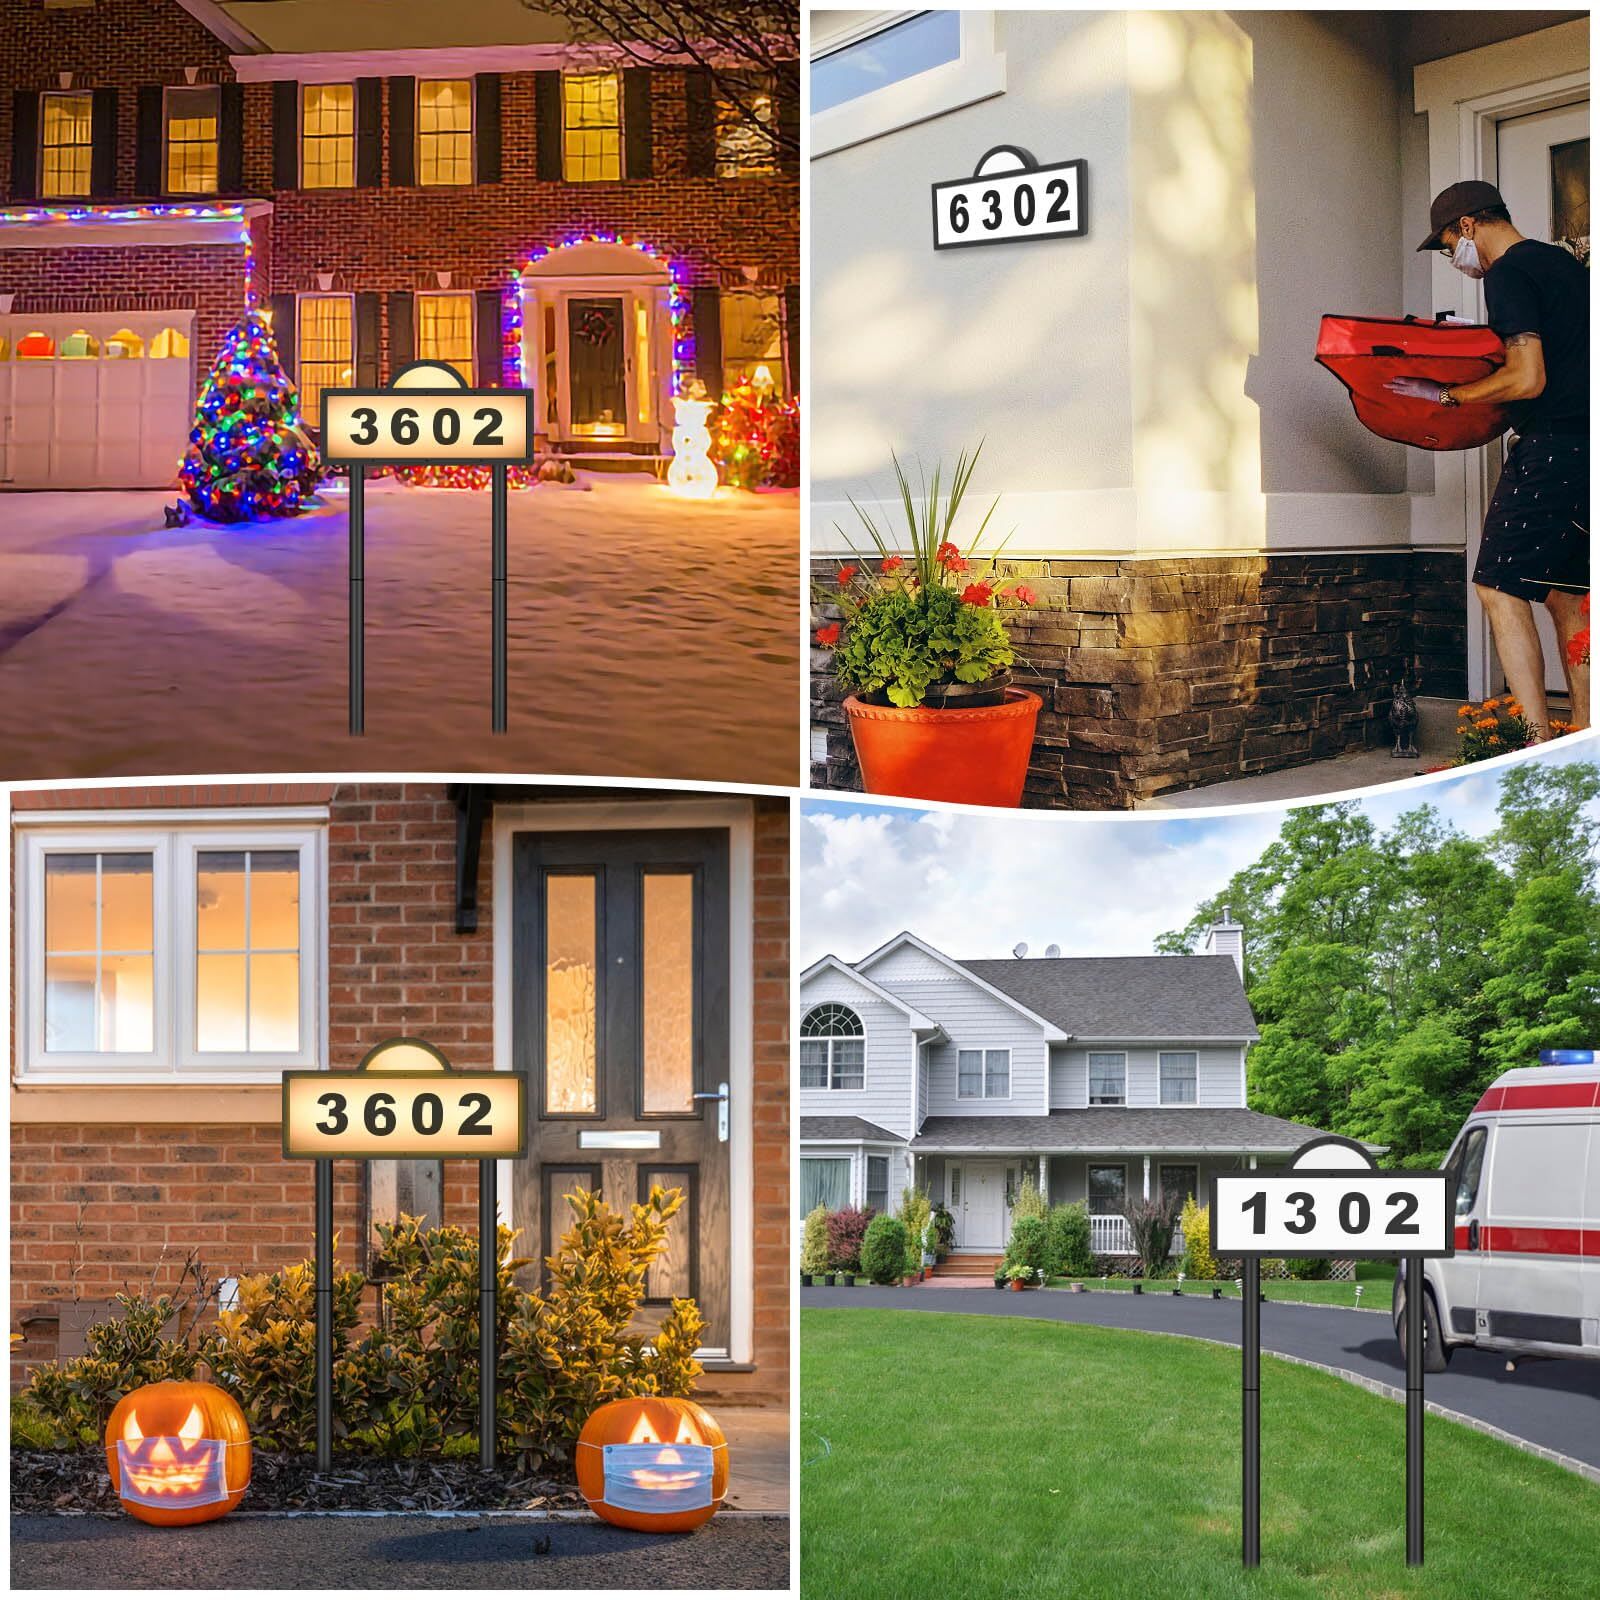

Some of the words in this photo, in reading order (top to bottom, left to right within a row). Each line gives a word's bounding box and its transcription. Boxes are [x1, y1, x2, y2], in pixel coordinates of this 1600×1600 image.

[949, 178, 1071, 234] 6302
[350, 407, 504, 446] 3602
[316, 1092, 493, 1137] 3602
[1240, 1191, 1420, 1235] 1302
